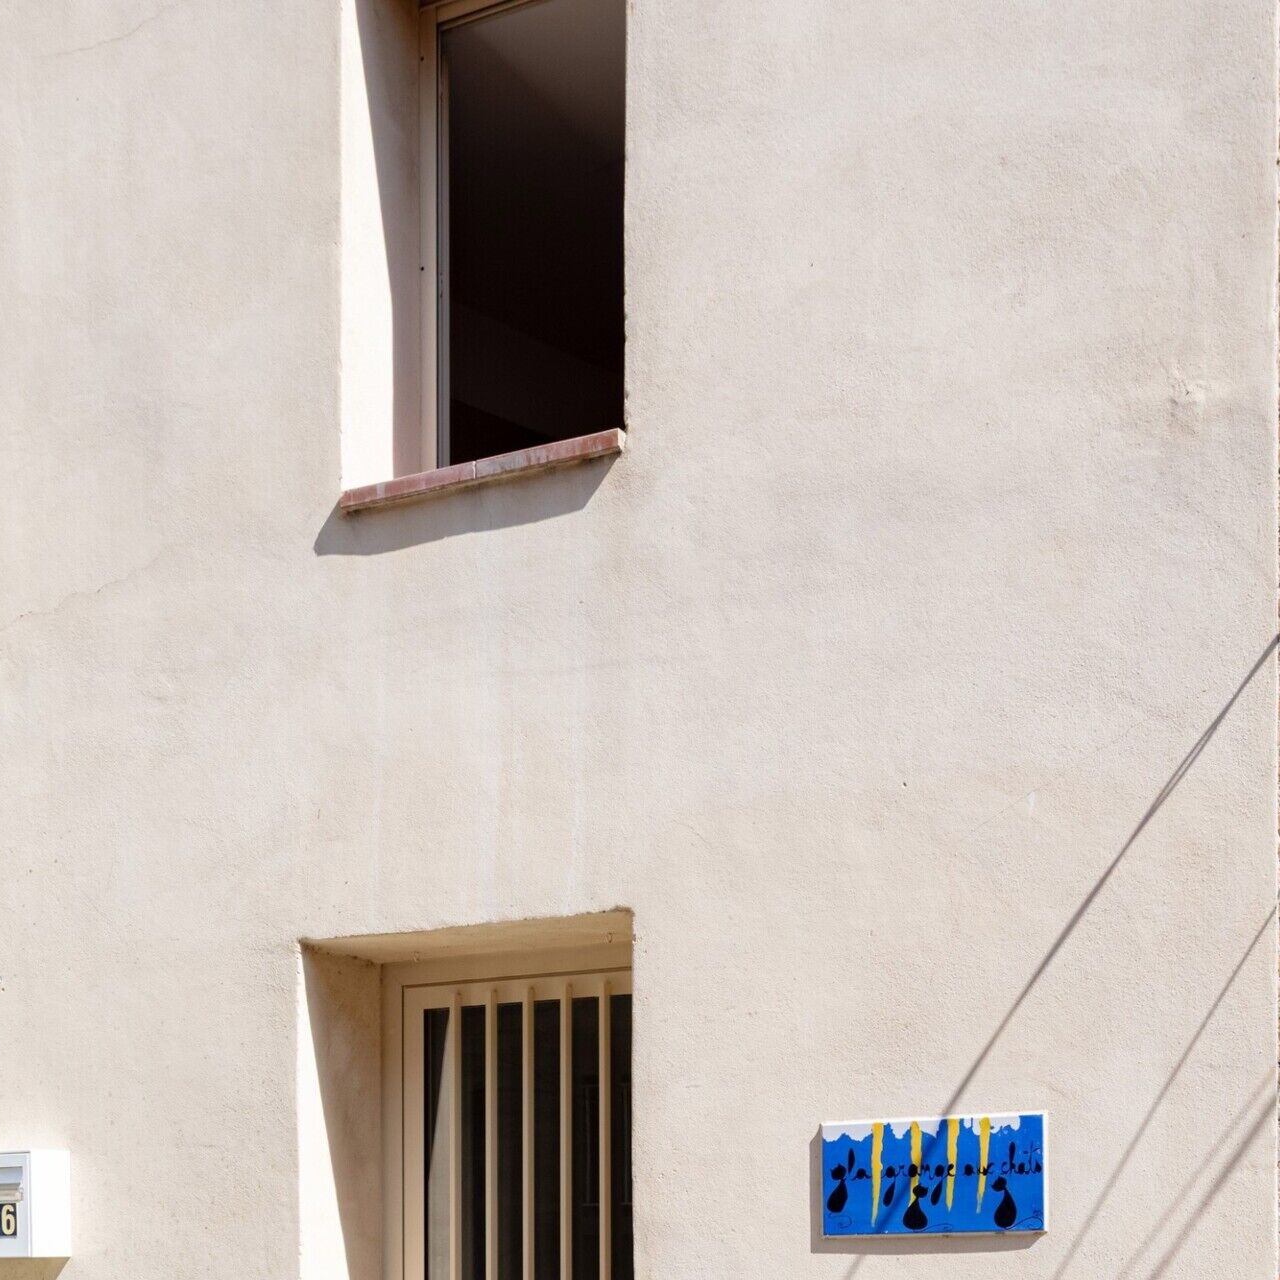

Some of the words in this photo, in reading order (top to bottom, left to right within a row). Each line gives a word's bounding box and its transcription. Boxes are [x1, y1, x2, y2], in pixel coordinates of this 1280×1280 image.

[880, 1163, 956, 1207] grange
[1001, 1141, 1042, 1175] chats
[1, 1204, 15, 1235] 6
